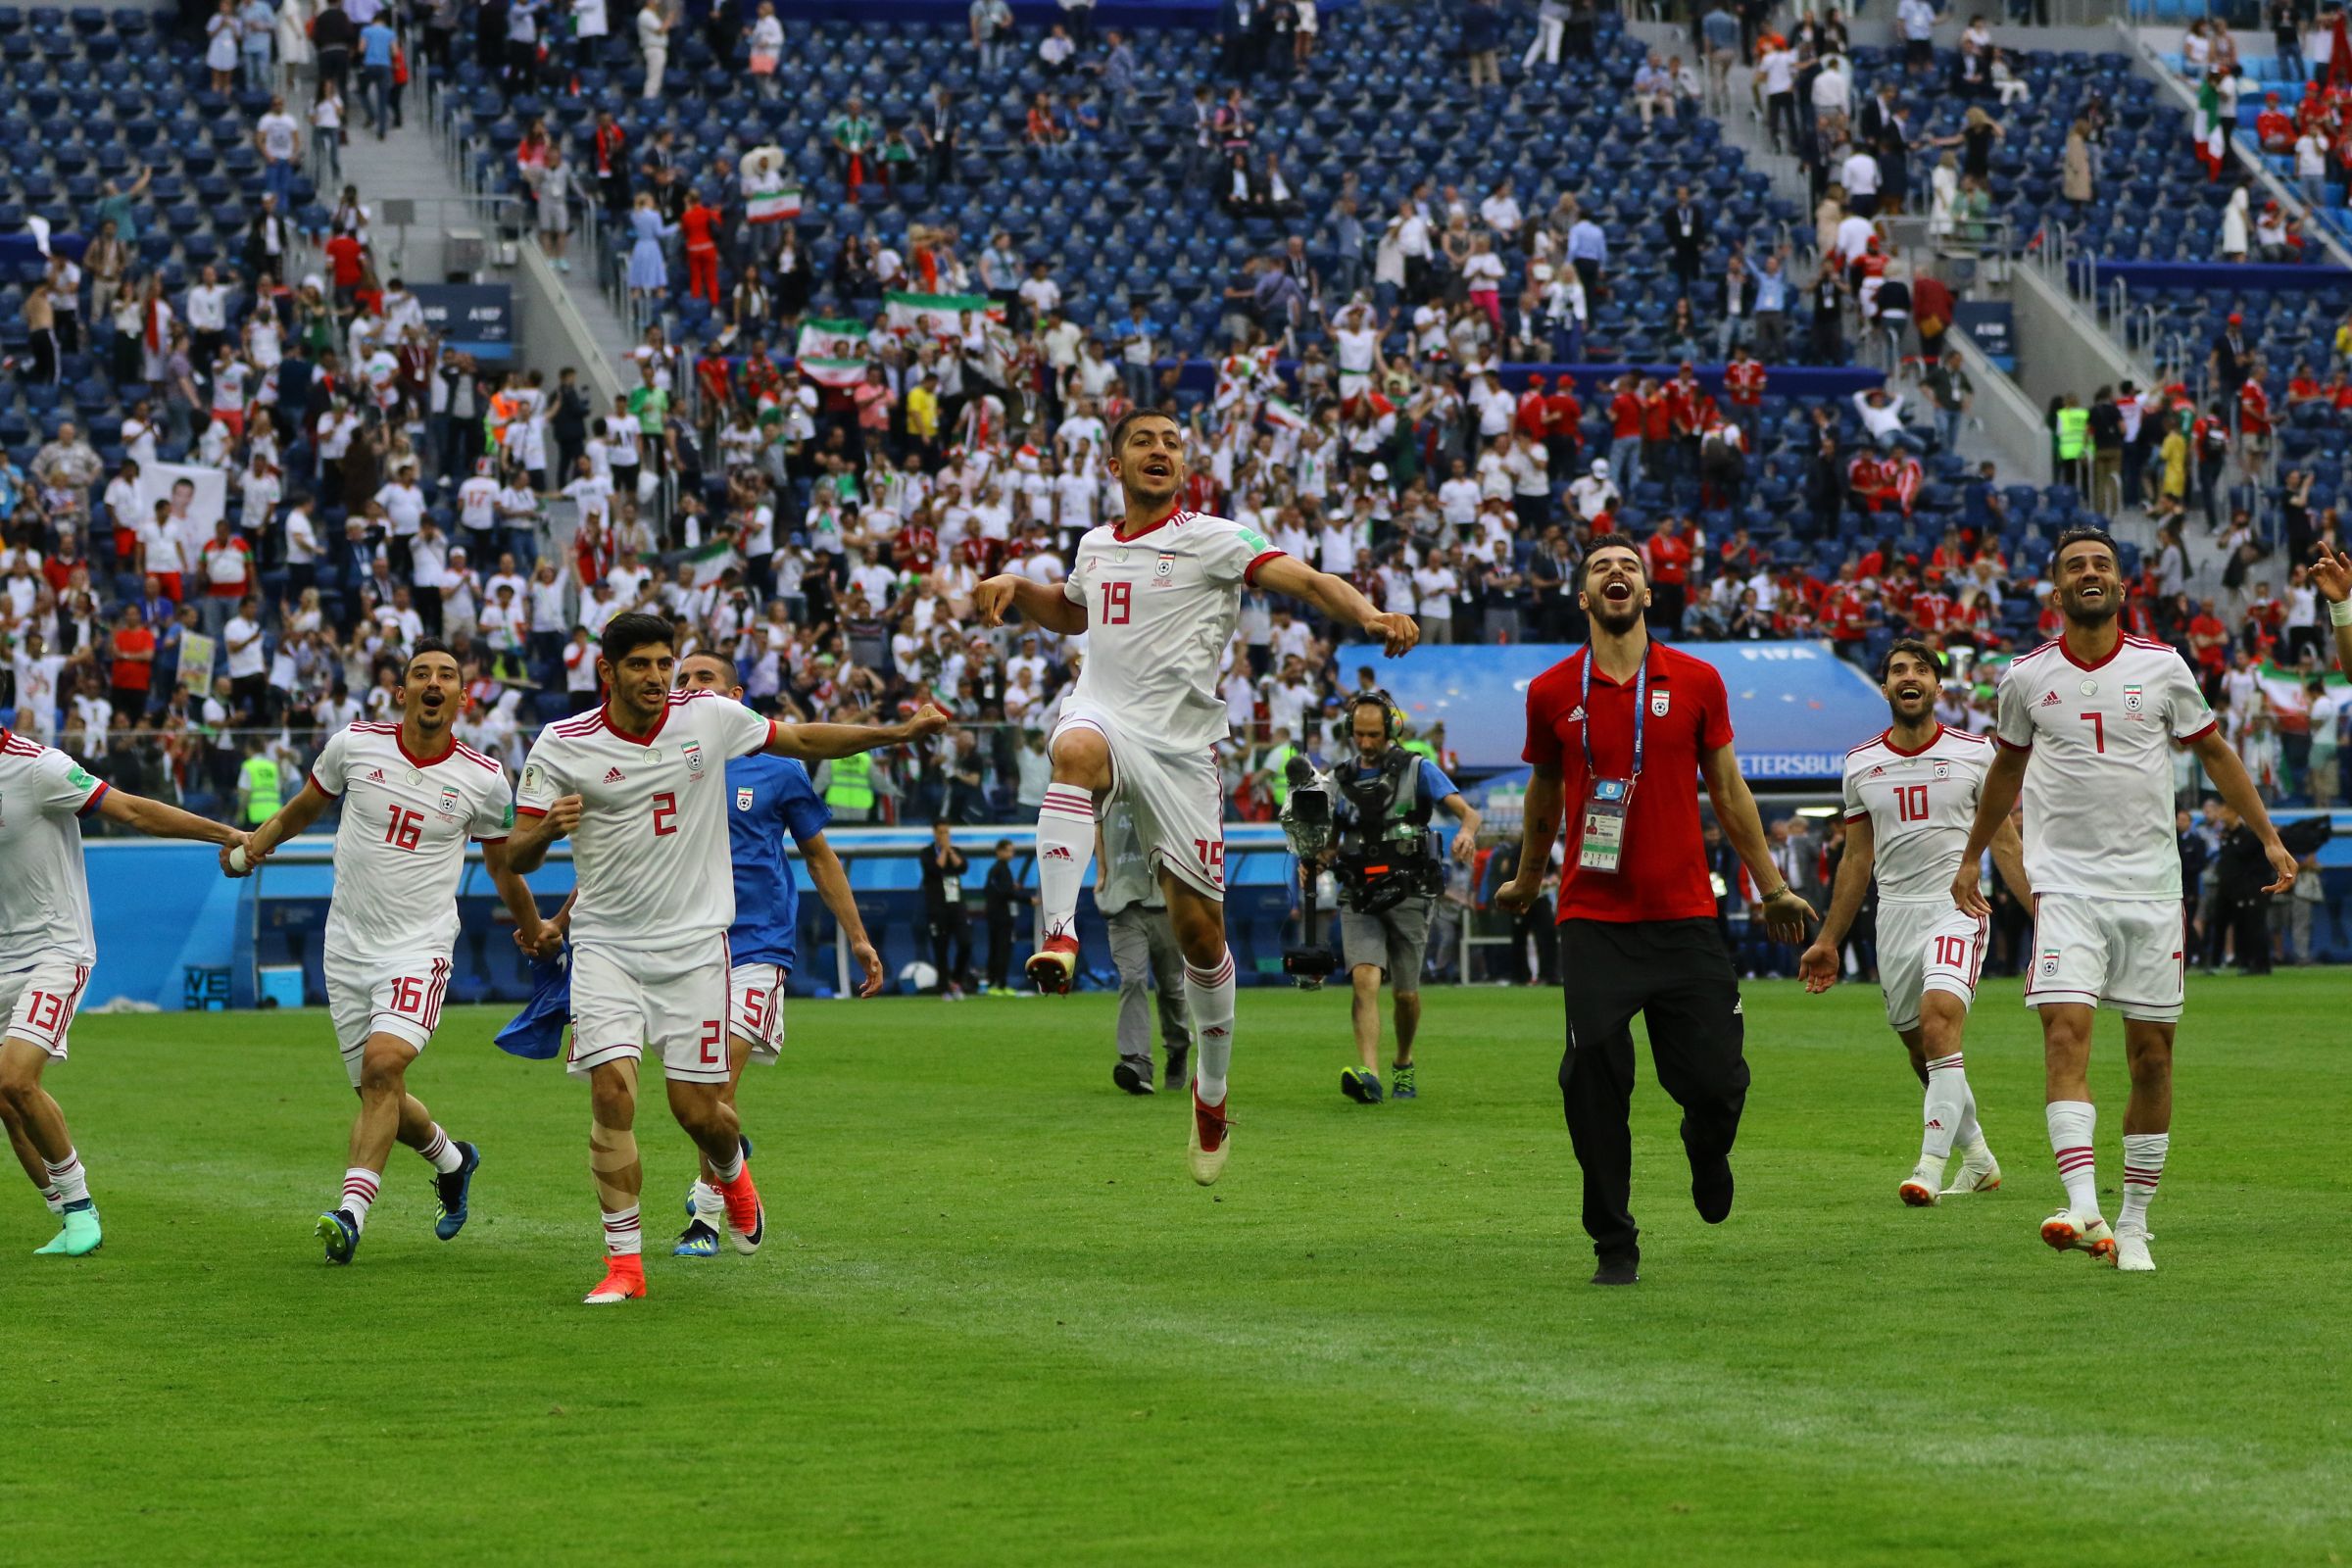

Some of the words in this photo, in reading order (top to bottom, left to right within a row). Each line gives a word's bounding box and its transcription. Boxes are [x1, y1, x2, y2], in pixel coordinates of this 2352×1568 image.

[1101, 582, 1132, 624] 19
[1740, 648, 1816, 661] FIFA
[2081, 712, 2104, 754] 7
[366, 774, 386, 784] adidas
[603, 775, 626, 784] adidas
[653, 792, 677, 836] 2
[1893, 785, 1929, 821] 10
[385, 804, 424, 851] 16
[1936, 936, 1966, 969] 10
[27, 991, 63, 1032] 13
[390, 976, 424, 1013] 16
[744, 988, 765, 1029] 5
[700, 1020, 720, 1064] 2
